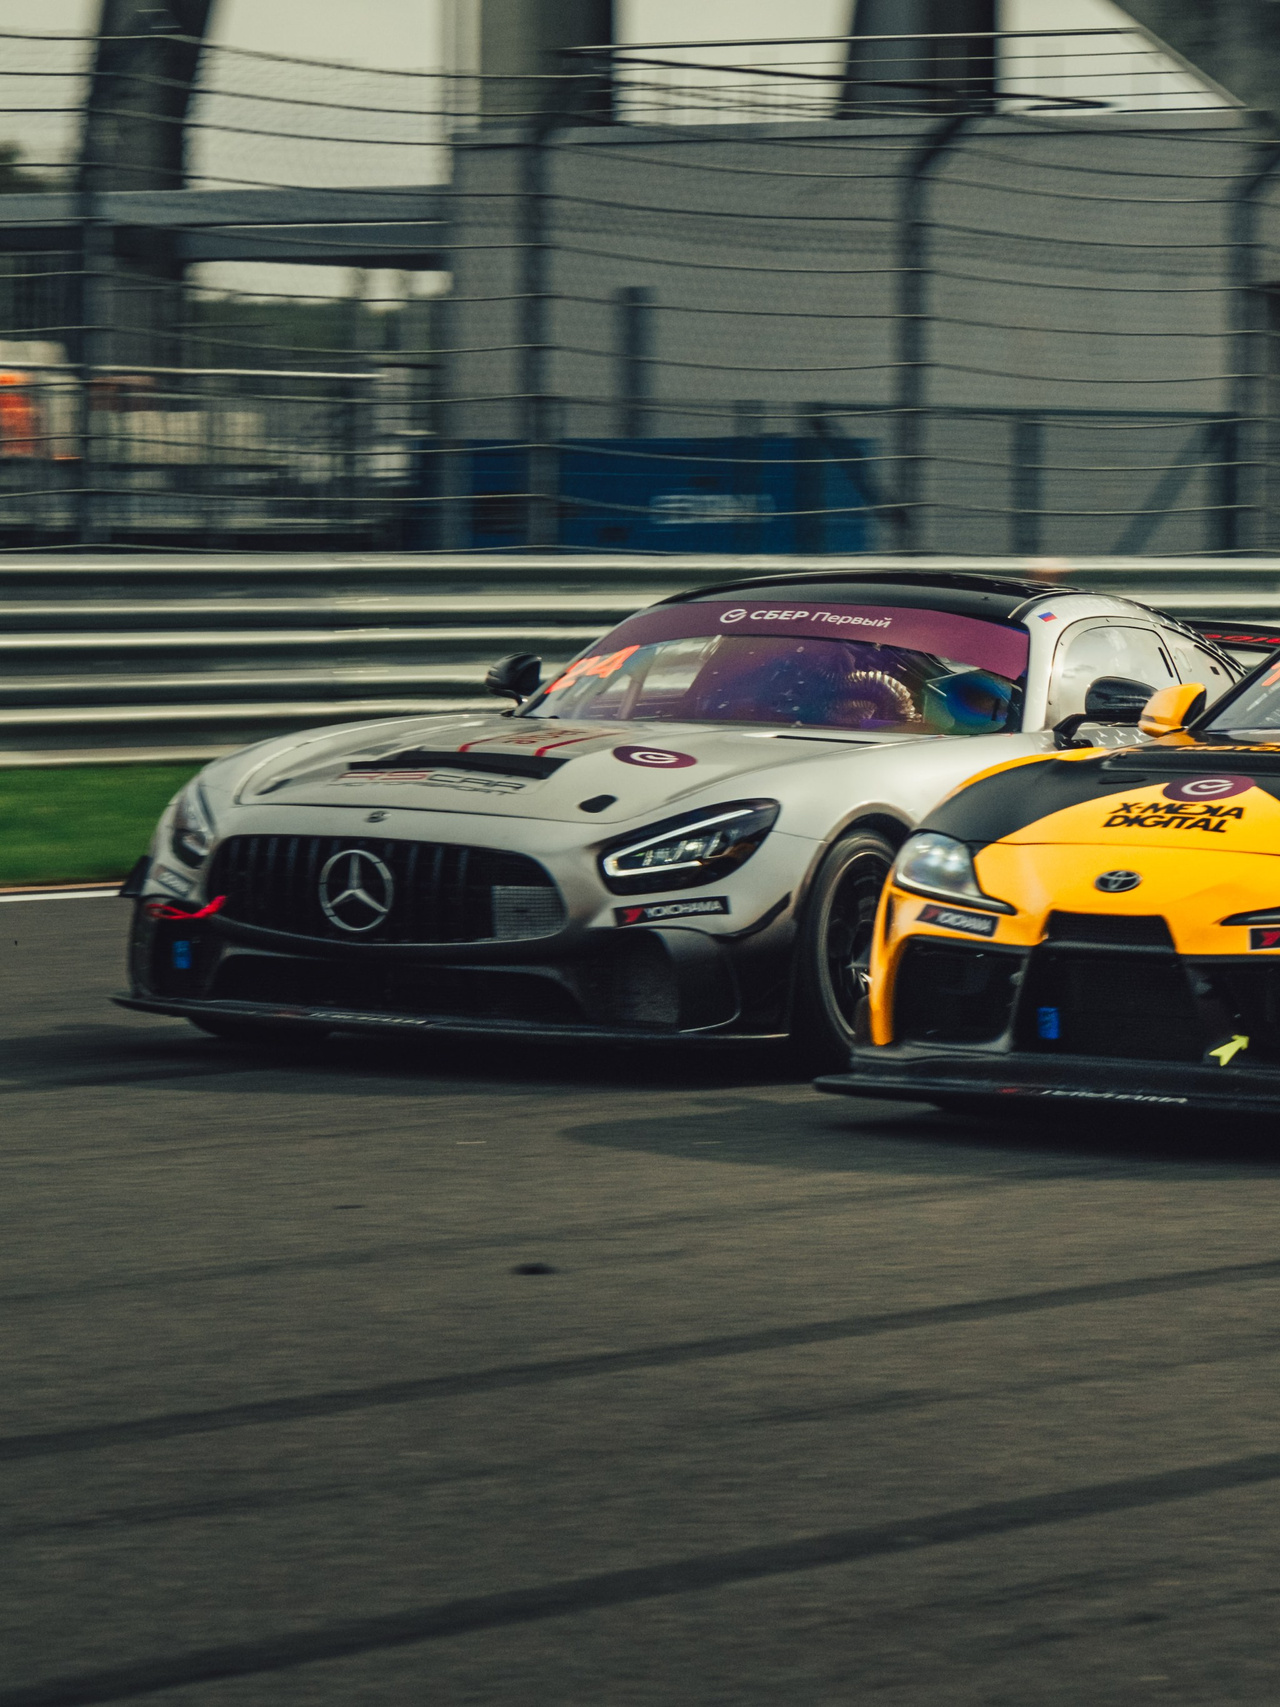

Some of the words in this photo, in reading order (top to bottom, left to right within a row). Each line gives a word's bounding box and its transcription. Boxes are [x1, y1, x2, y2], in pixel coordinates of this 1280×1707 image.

[750, 610, 809, 621] СБЕР
[811, 611, 893, 628] Первый
[1102, 815, 1227, 833] DIGITAL
